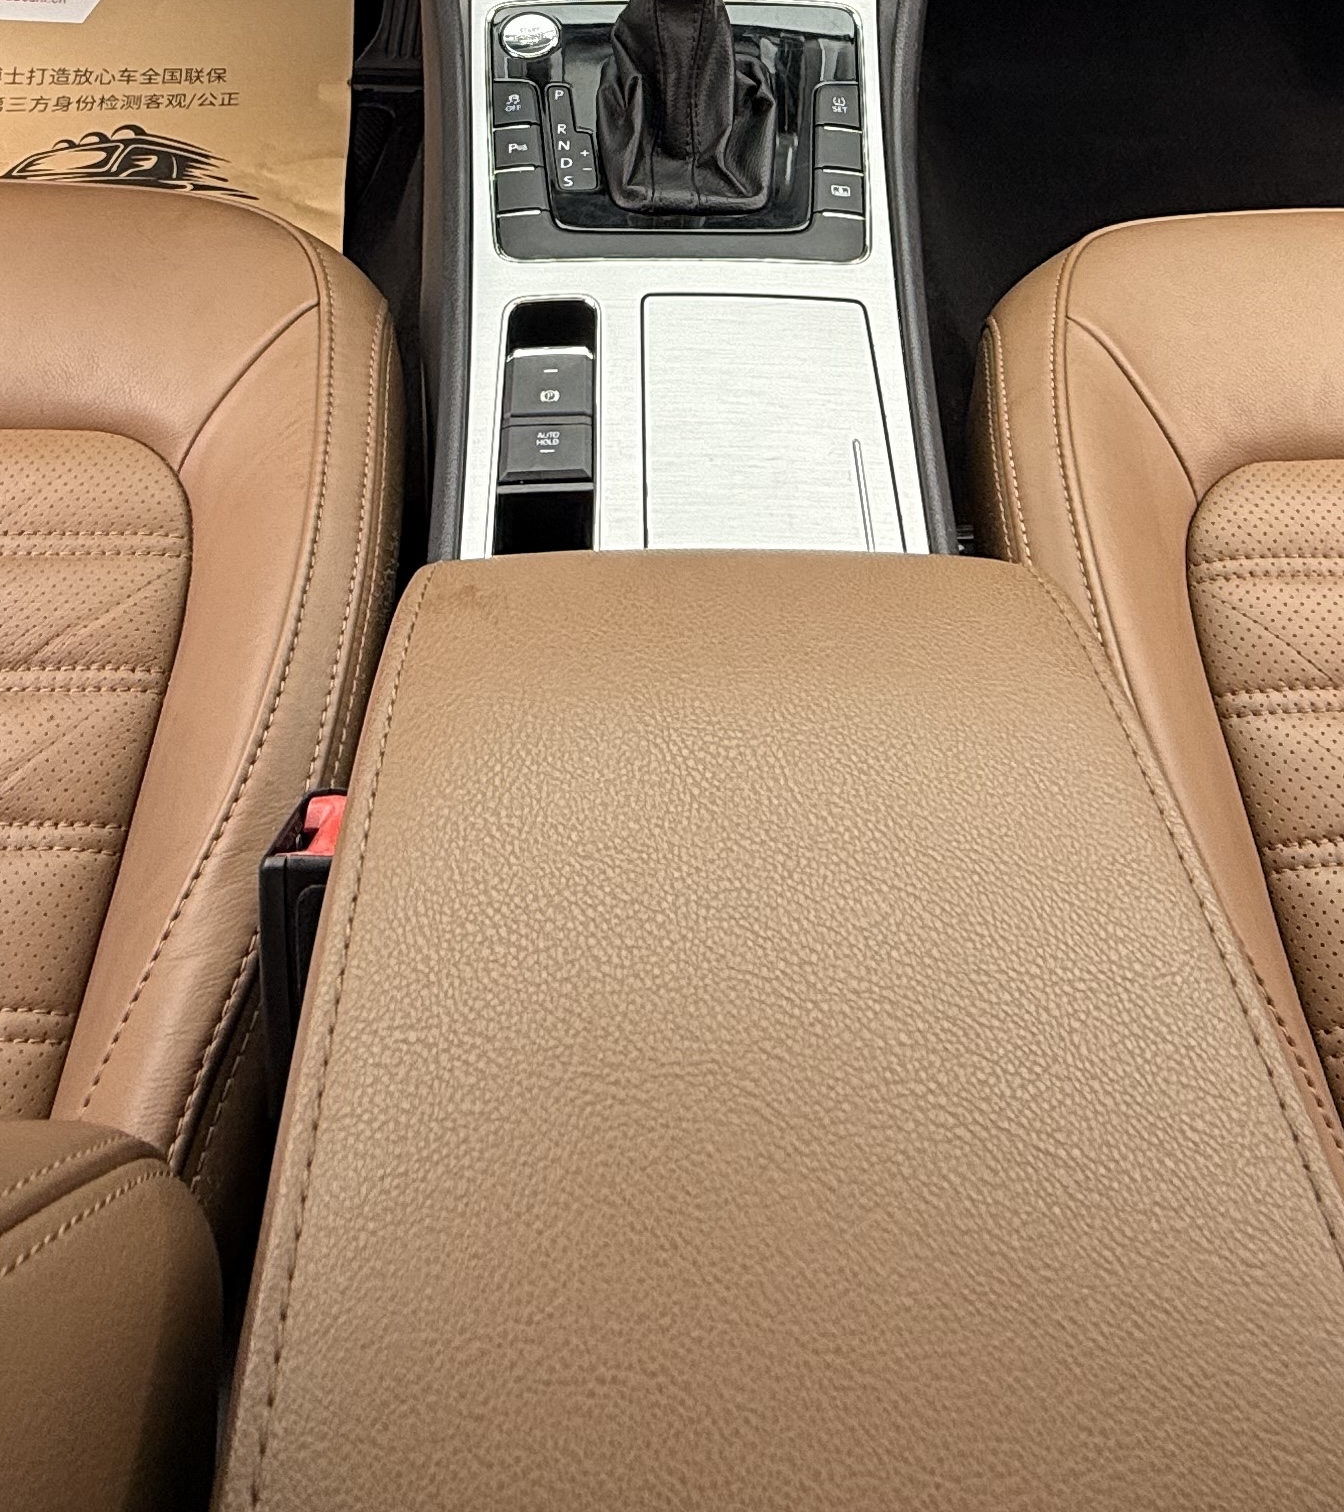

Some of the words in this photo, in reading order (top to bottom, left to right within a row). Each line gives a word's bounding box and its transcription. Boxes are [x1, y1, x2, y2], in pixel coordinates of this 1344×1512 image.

[554, 89, 565, 101] P
[831, 105, 848, 113] SET
[557, 123, 567, 135] R
[558, 140, 571, 151] N
[560, 157, 573, 169] D
[563, 175, 574, 187] S
[537, 431, 560, 439] AUTO
[536, 438, 560, 446] HOLD
